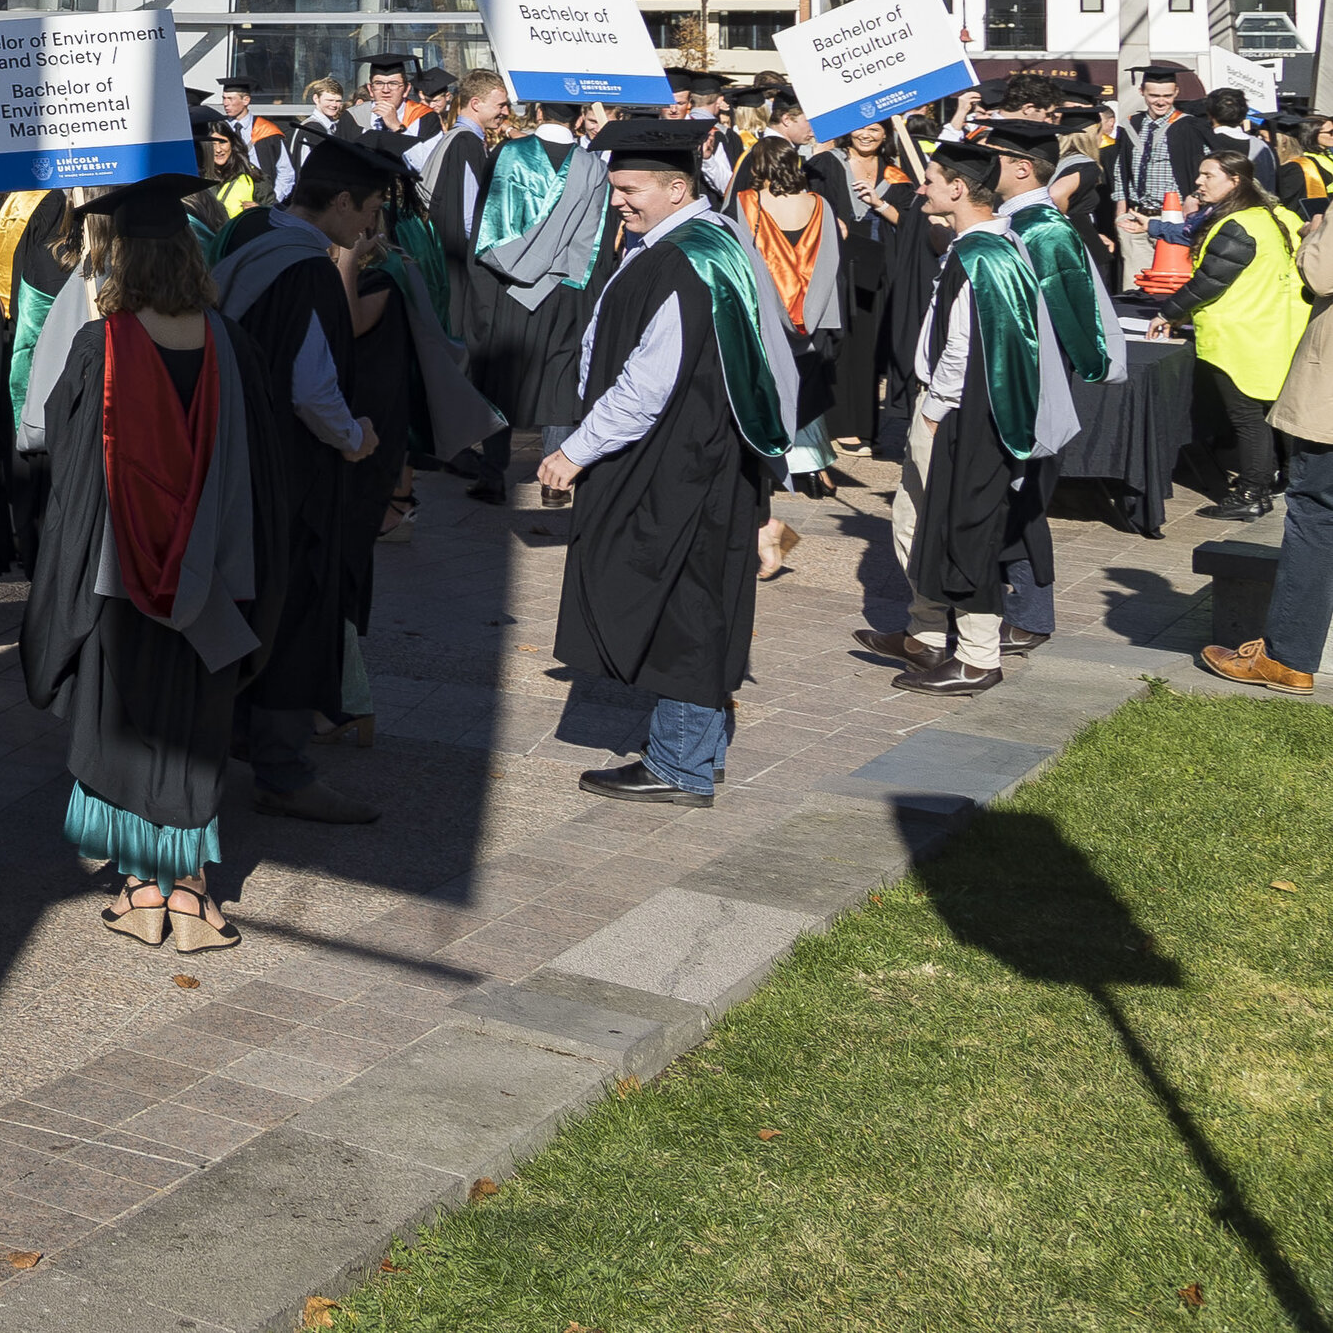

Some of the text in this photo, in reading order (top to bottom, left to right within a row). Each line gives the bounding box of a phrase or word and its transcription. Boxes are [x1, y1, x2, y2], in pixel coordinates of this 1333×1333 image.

[518, 4, 610, 23] Bachelor of
[30, 32, 47, 48] of
[52, 25, 166, 47] Environment
[529, 26, 618, 45] Agriculture
[812, 4, 903, 52] Bachelor of
[36, 49, 102, 67] Society
[112, 46, 118, 64] /
[821, 23, 914, 71] Agricultural
[841, 51, 906, 84] Science
[1227, 65, 1256, 84] Bachelor
[12, 78, 113, 99] Bachelor of
[1, 95, 130, 119] Environmental
[10, 116, 128, 139] Management
[56, 156, 99, 165] LINCOLN
[58, 162, 118, 172] UNIVERSITY
